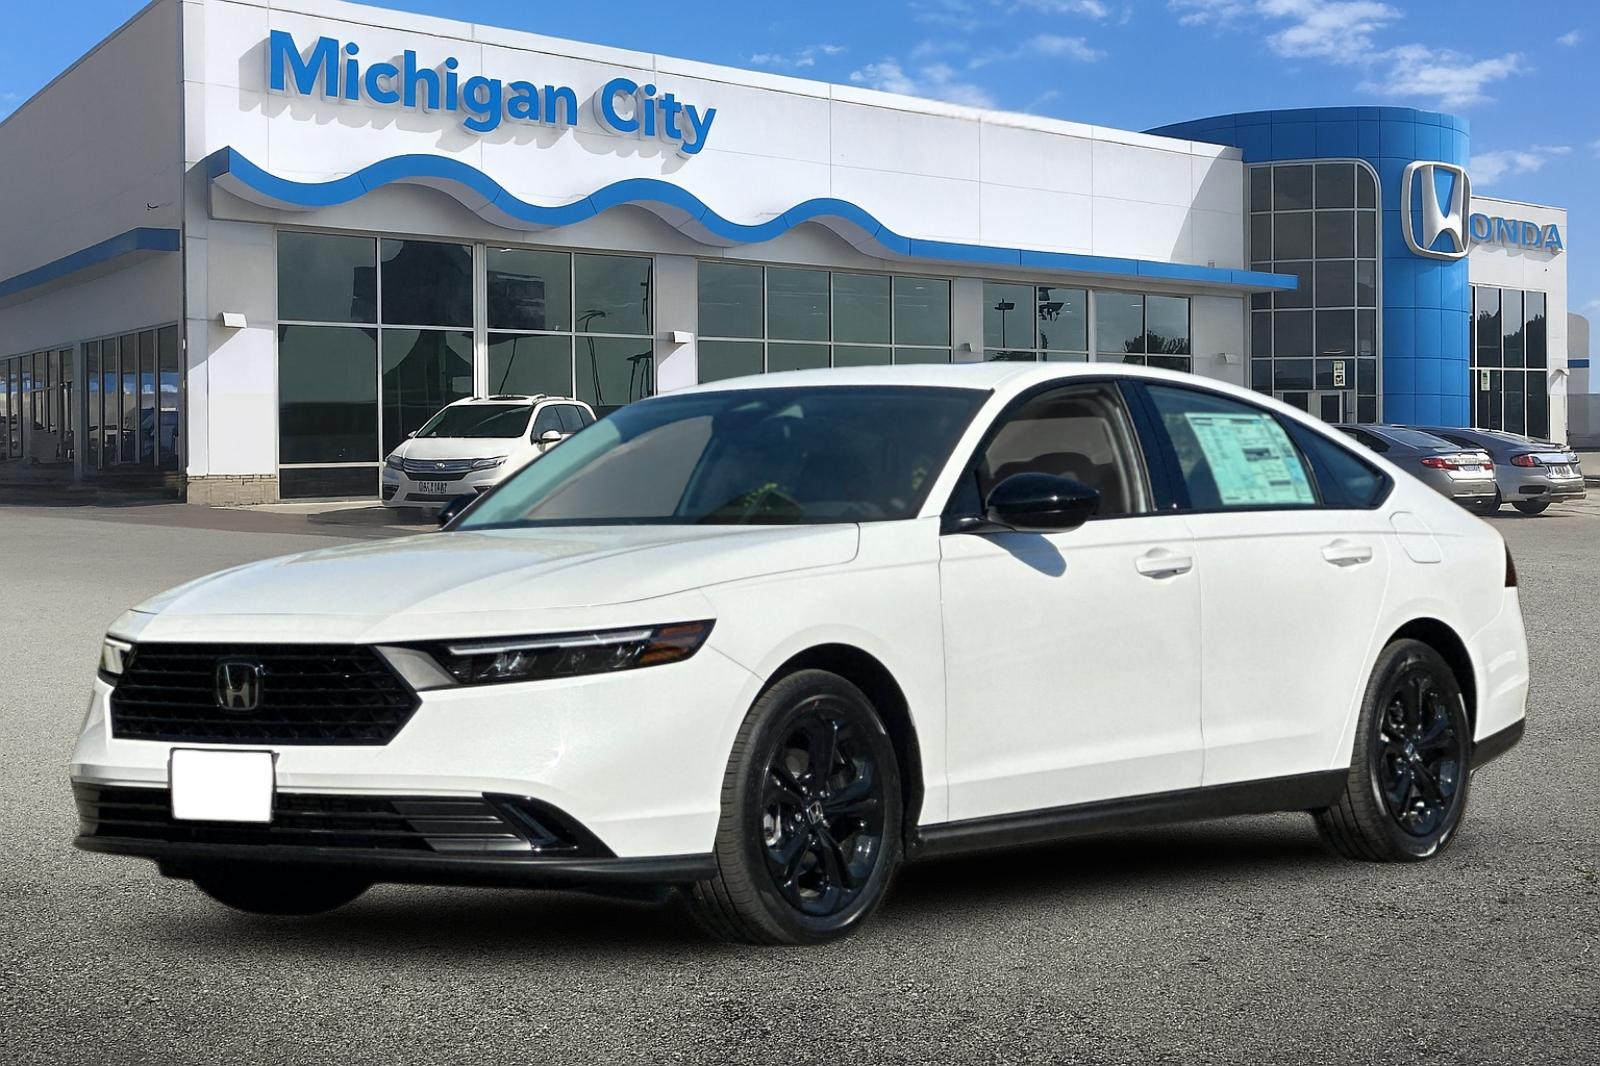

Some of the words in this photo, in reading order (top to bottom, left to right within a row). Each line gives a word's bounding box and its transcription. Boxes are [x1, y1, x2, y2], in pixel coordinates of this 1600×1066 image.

[269, 29, 578, 133] Michigan
[599, 77, 717, 155] City
[1469, 212, 1563, 250] ONDA
